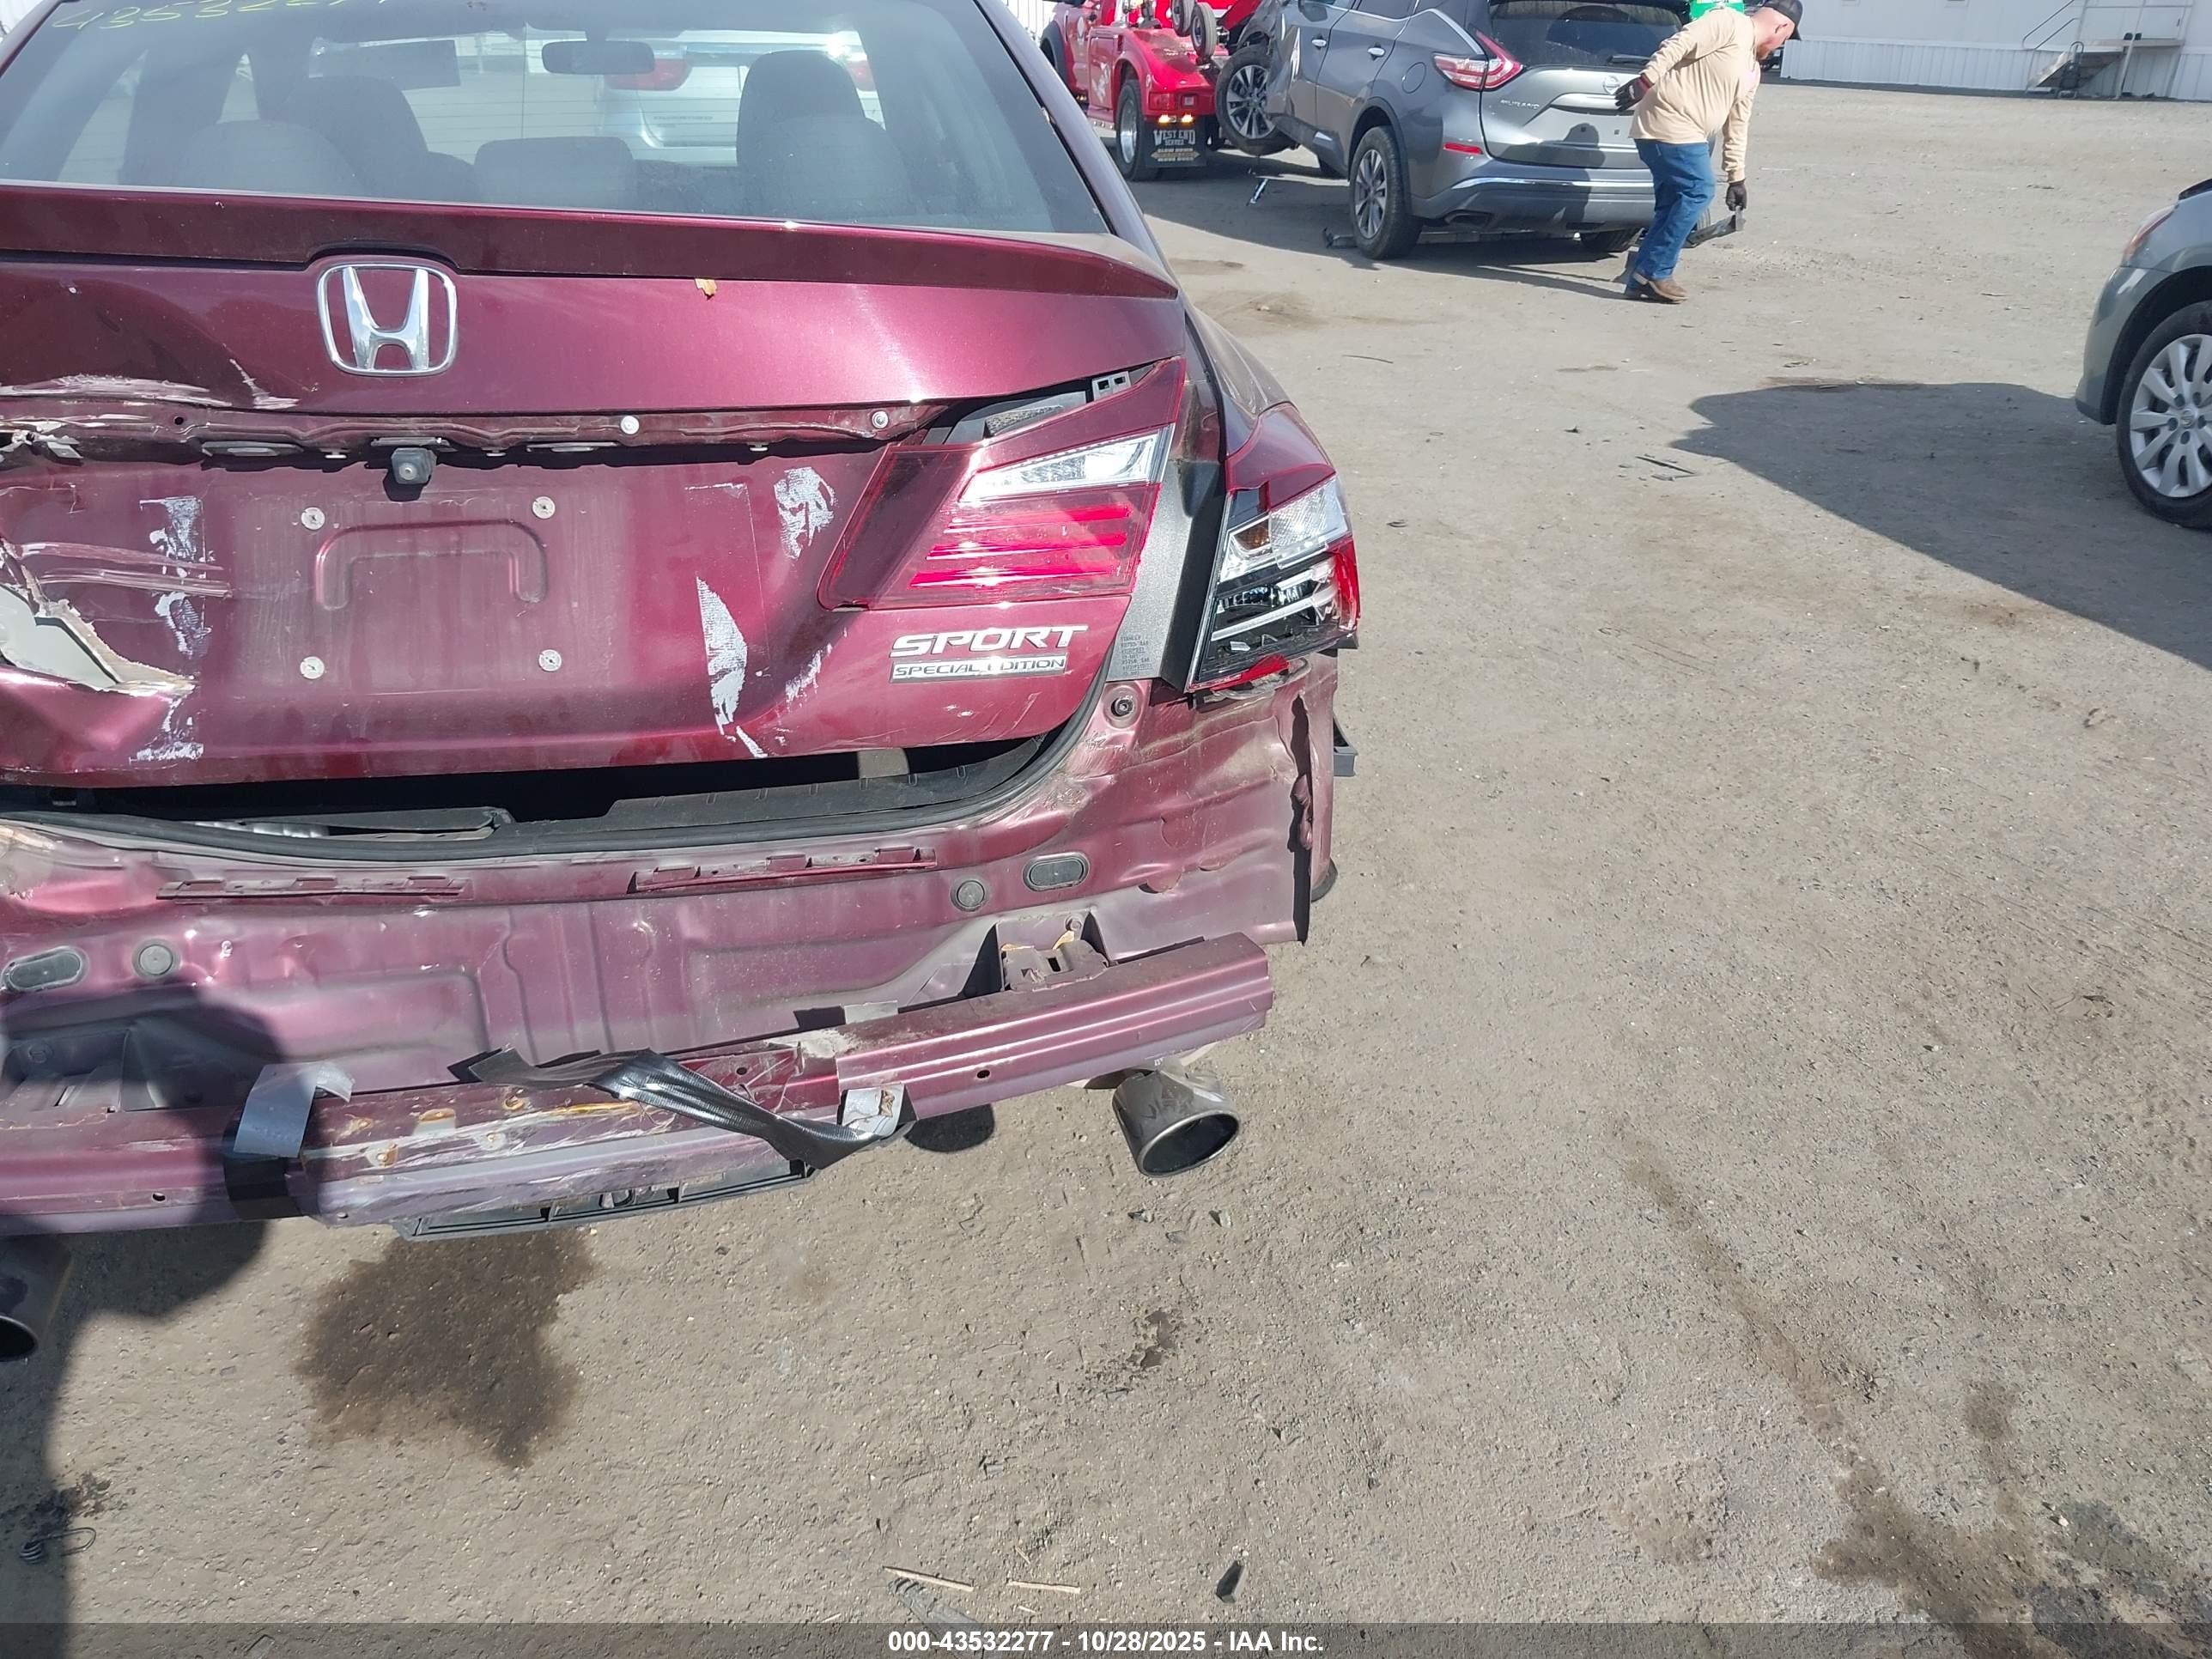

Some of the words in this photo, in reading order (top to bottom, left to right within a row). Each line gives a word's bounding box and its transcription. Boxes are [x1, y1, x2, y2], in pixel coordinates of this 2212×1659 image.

[1153, 130, 1177, 146] WEST
[1178, 130, 1196, 145] END
[890, 625, 1089, 658] SPORT
[896, 664, 979, 677] SPECIAL
